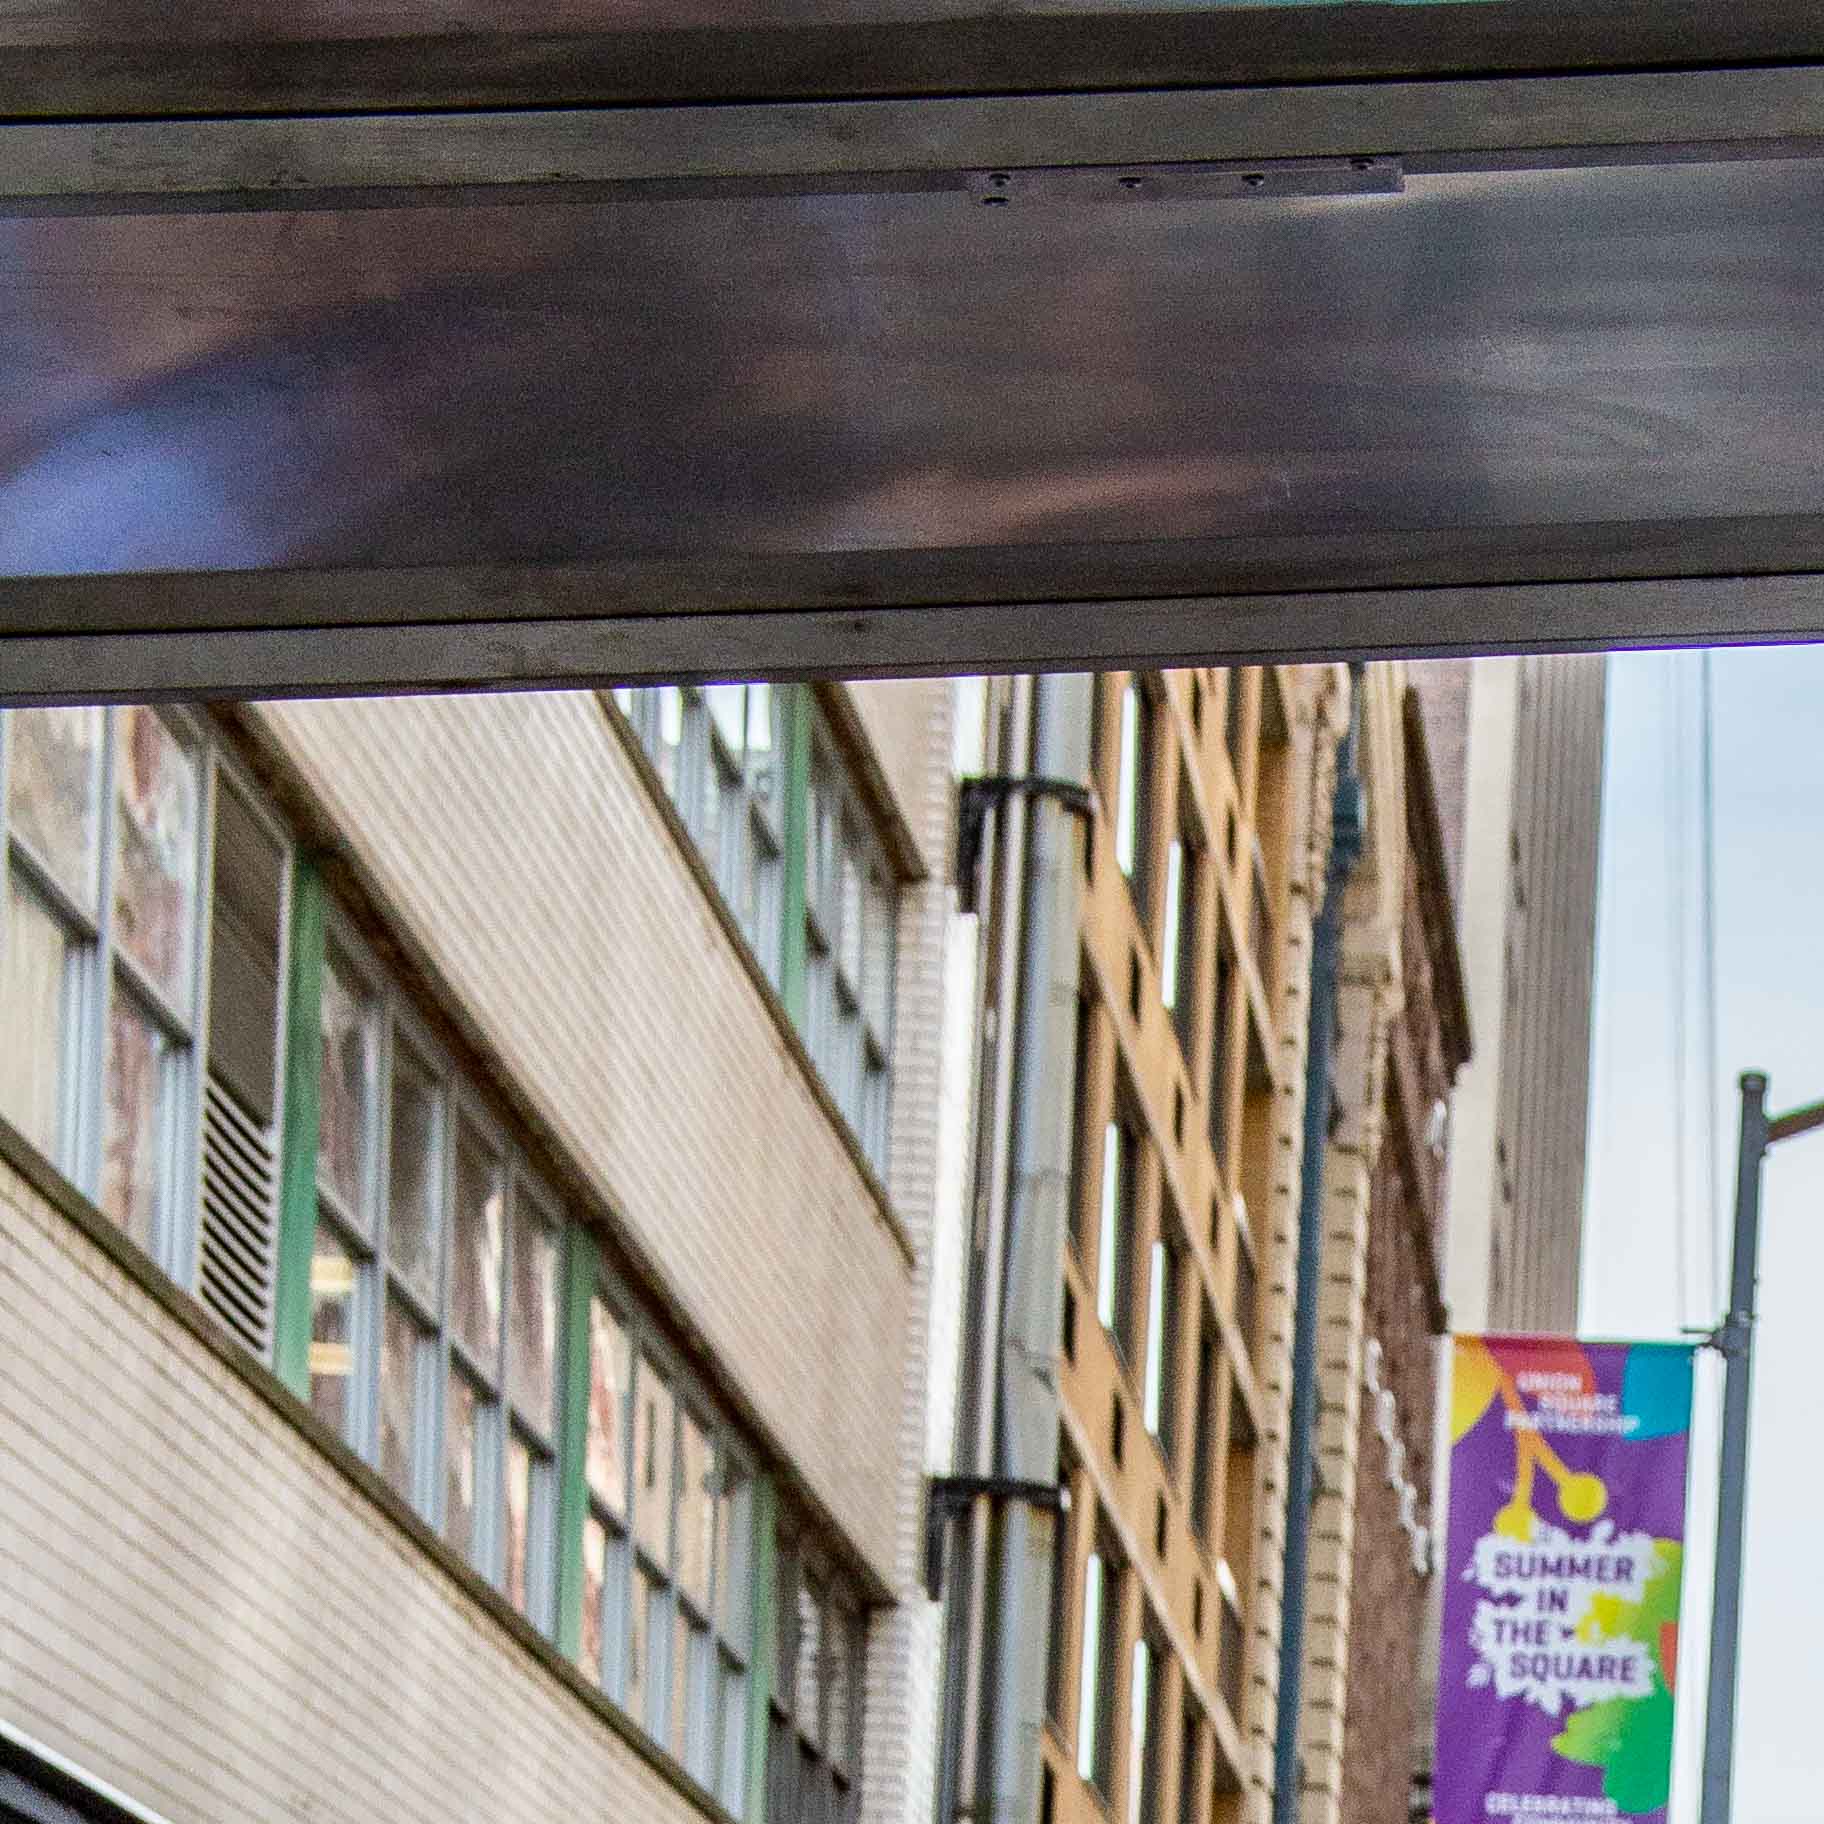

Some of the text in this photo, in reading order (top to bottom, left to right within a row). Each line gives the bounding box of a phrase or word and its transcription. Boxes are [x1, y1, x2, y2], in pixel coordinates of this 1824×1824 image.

[1494, 1550, 1634, 1584] SUMMER
[1537, 1587, 1569, 1612] IN
[1494, 1618, 1549, 1645] THE
[1510, 1651, 1636, 1684] SQUARE
